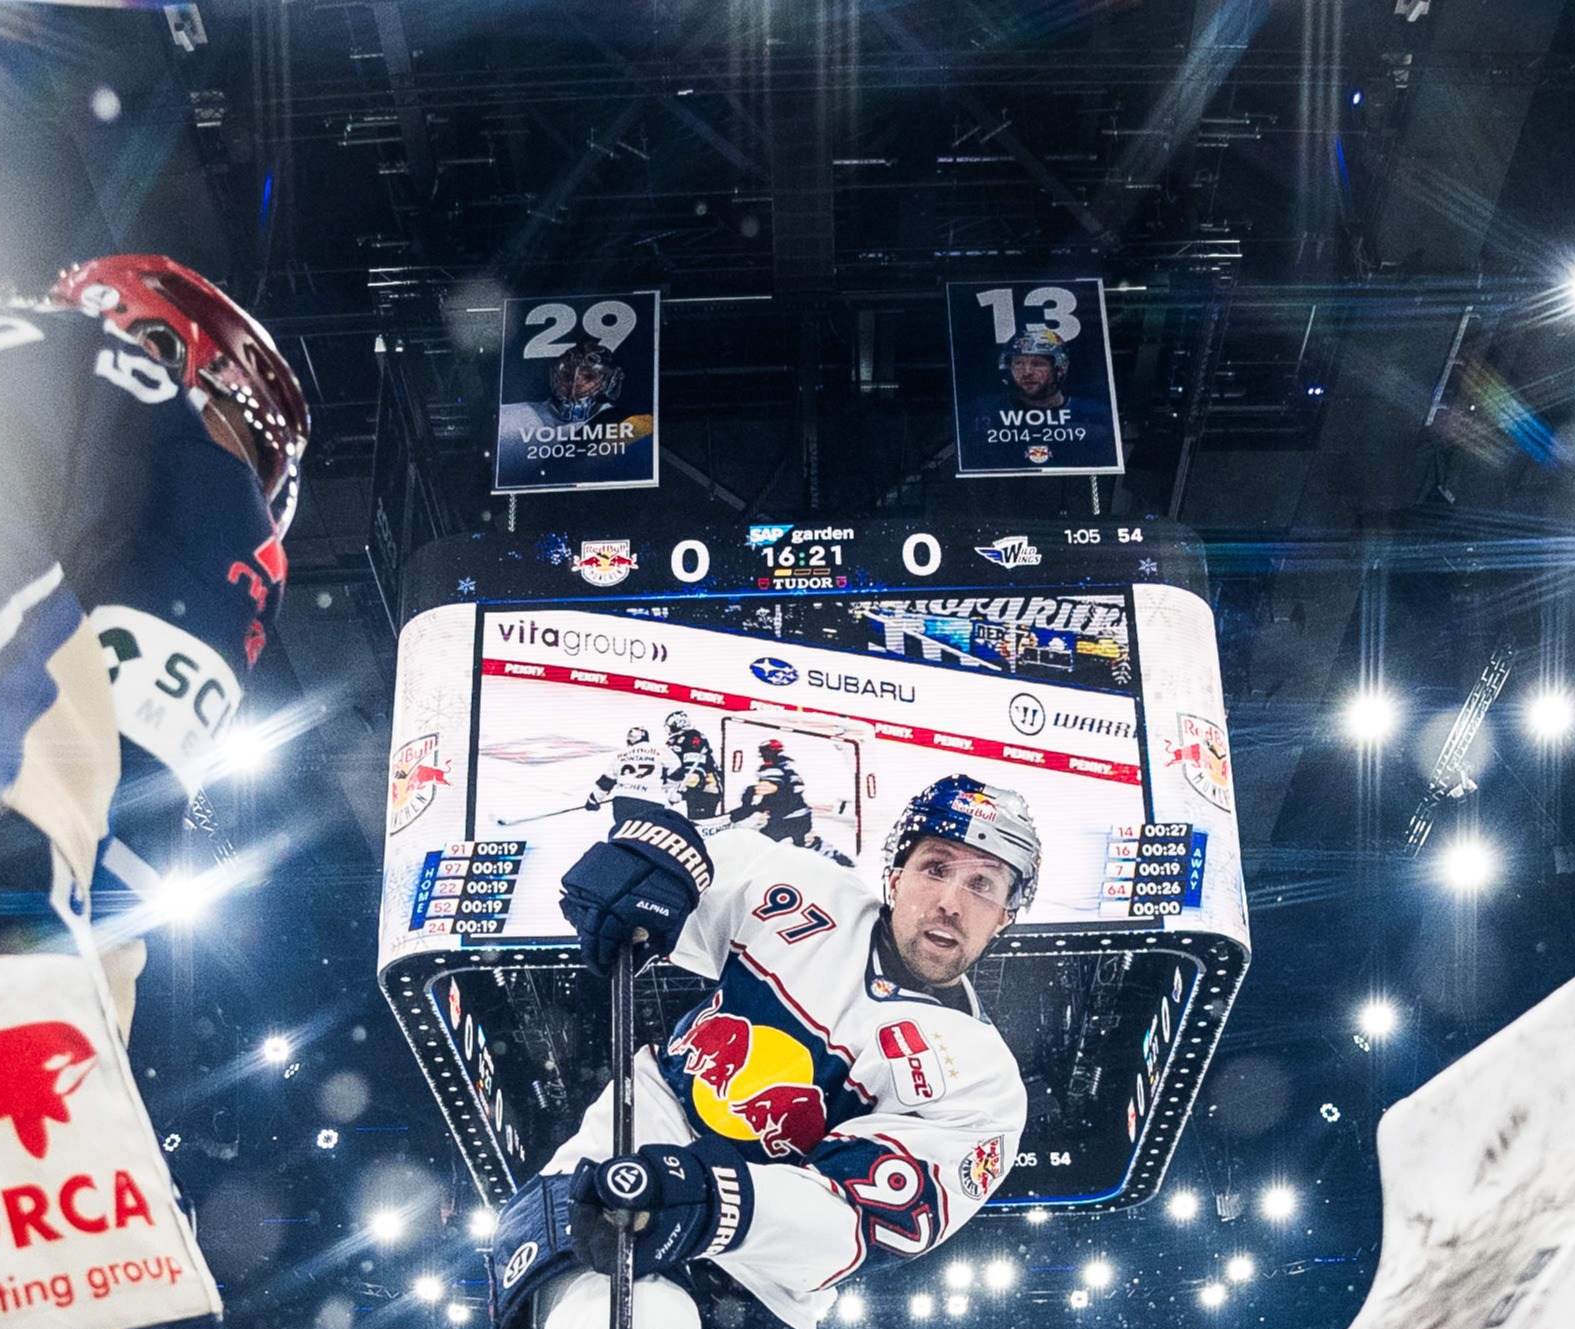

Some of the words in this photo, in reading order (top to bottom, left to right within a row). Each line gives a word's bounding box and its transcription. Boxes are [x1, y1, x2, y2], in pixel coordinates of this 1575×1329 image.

[976, 287, 1083, 345] 13
[522, 300, 637, 359] 29
[998, 408, 1072, 427] WOLF
[519, 421, 635, 445] VOLLMER
[750, 528, 784, 543] SAP
[791, 526, 854, 544] garden
[1064, 528, 1101, 544] 1:05
[1118, 527, 1143, 543] 54
[670, 539, 710, 583] 0
[762, 545, 843, 567] 16:21
[902, 533, 942, 577] 0
[773, 577, 834, 590] TUDOR
[807, 670, 917, 703] SUBARU
[1118, 828, 1134, 838] 14
[1144, 825, 1187, 837] 00:27
[451, 844, 466, 855] 91
[477, 843, 518, 855] 00:19
[612, 820, 711, 895] WARRIO
[1115, 847, 1131, 857] 16
[1142, 844, 1186, 856] 00:26
[445, 864, 462, 875] 97
[472, 862, 513, 875] 00:19
[1116, 865, 1124, 875] 7
[1139, 863, 1180, 875] 00:19
[439, 882, 457, 893] 22
[467, 881, 508, 894] 00:19
[1107, 885, 1127, 896] 64
[1136, 883, 1181, 895] 00:26
[434, 902, 452, 913] 52
[461, 901, 503, 913] 00:19
[636, 899, 670, 917] ALPHA
[752, 884, 837, 945] 97
[1133, 903, 1180, 915] 00:00
[429, 922, 446, 933] 24
[456, 920, 497, 932] 00:19
[663, 1156, 685, 1180] 97
[1015, 1153, 1037, 1166] :05
[1050, 1152, 1072, 1167] 54
[842, 1153, 935, 1257] 97
[86, 1256, 182, 1300] group
